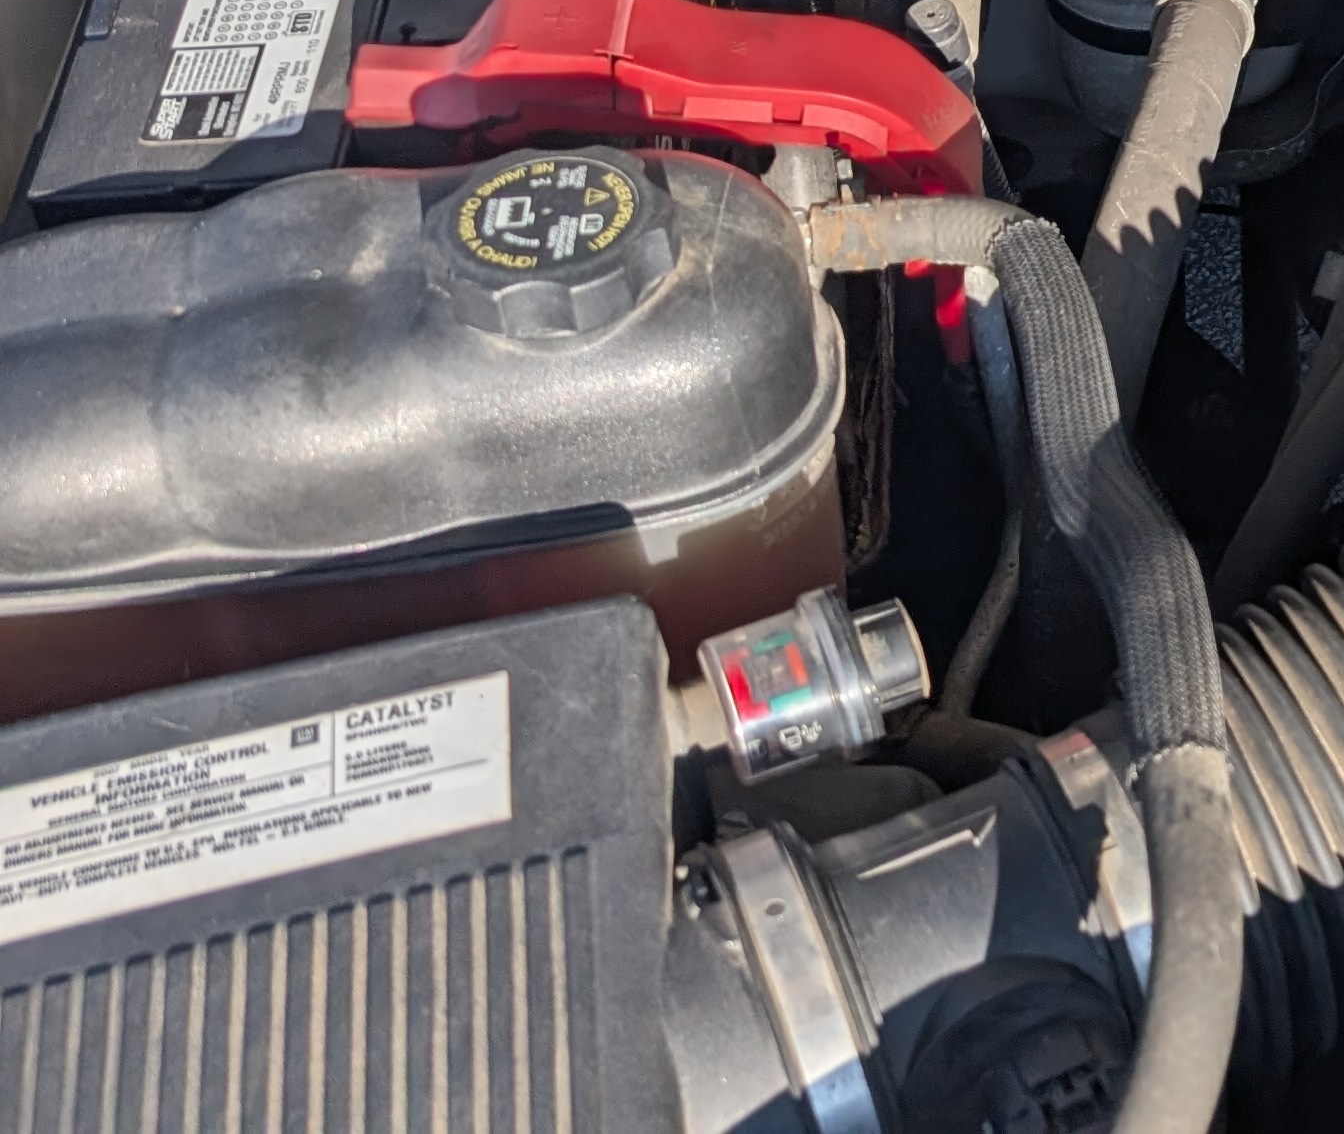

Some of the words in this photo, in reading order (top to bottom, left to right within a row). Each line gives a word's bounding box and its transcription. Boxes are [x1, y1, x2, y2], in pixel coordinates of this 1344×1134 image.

[149, 98, 173, 137] SUPER
[157, 99, 182, 140] START
[475, 166, 528, 198] JAMAIS
[531, 162, 555, 176] NE
[345, 689, 455, 731] CATALYST
[30, 780, 98, 809] VEHICLE
[107, 759, 187, 790] EMISSION
[193, 740, 269, 771] CONTROL
[94, 767, 210, 806] INFORMATION
[189, 790, 234, 810] SERVICE
[239, 778, 285, 799] MANUAL
